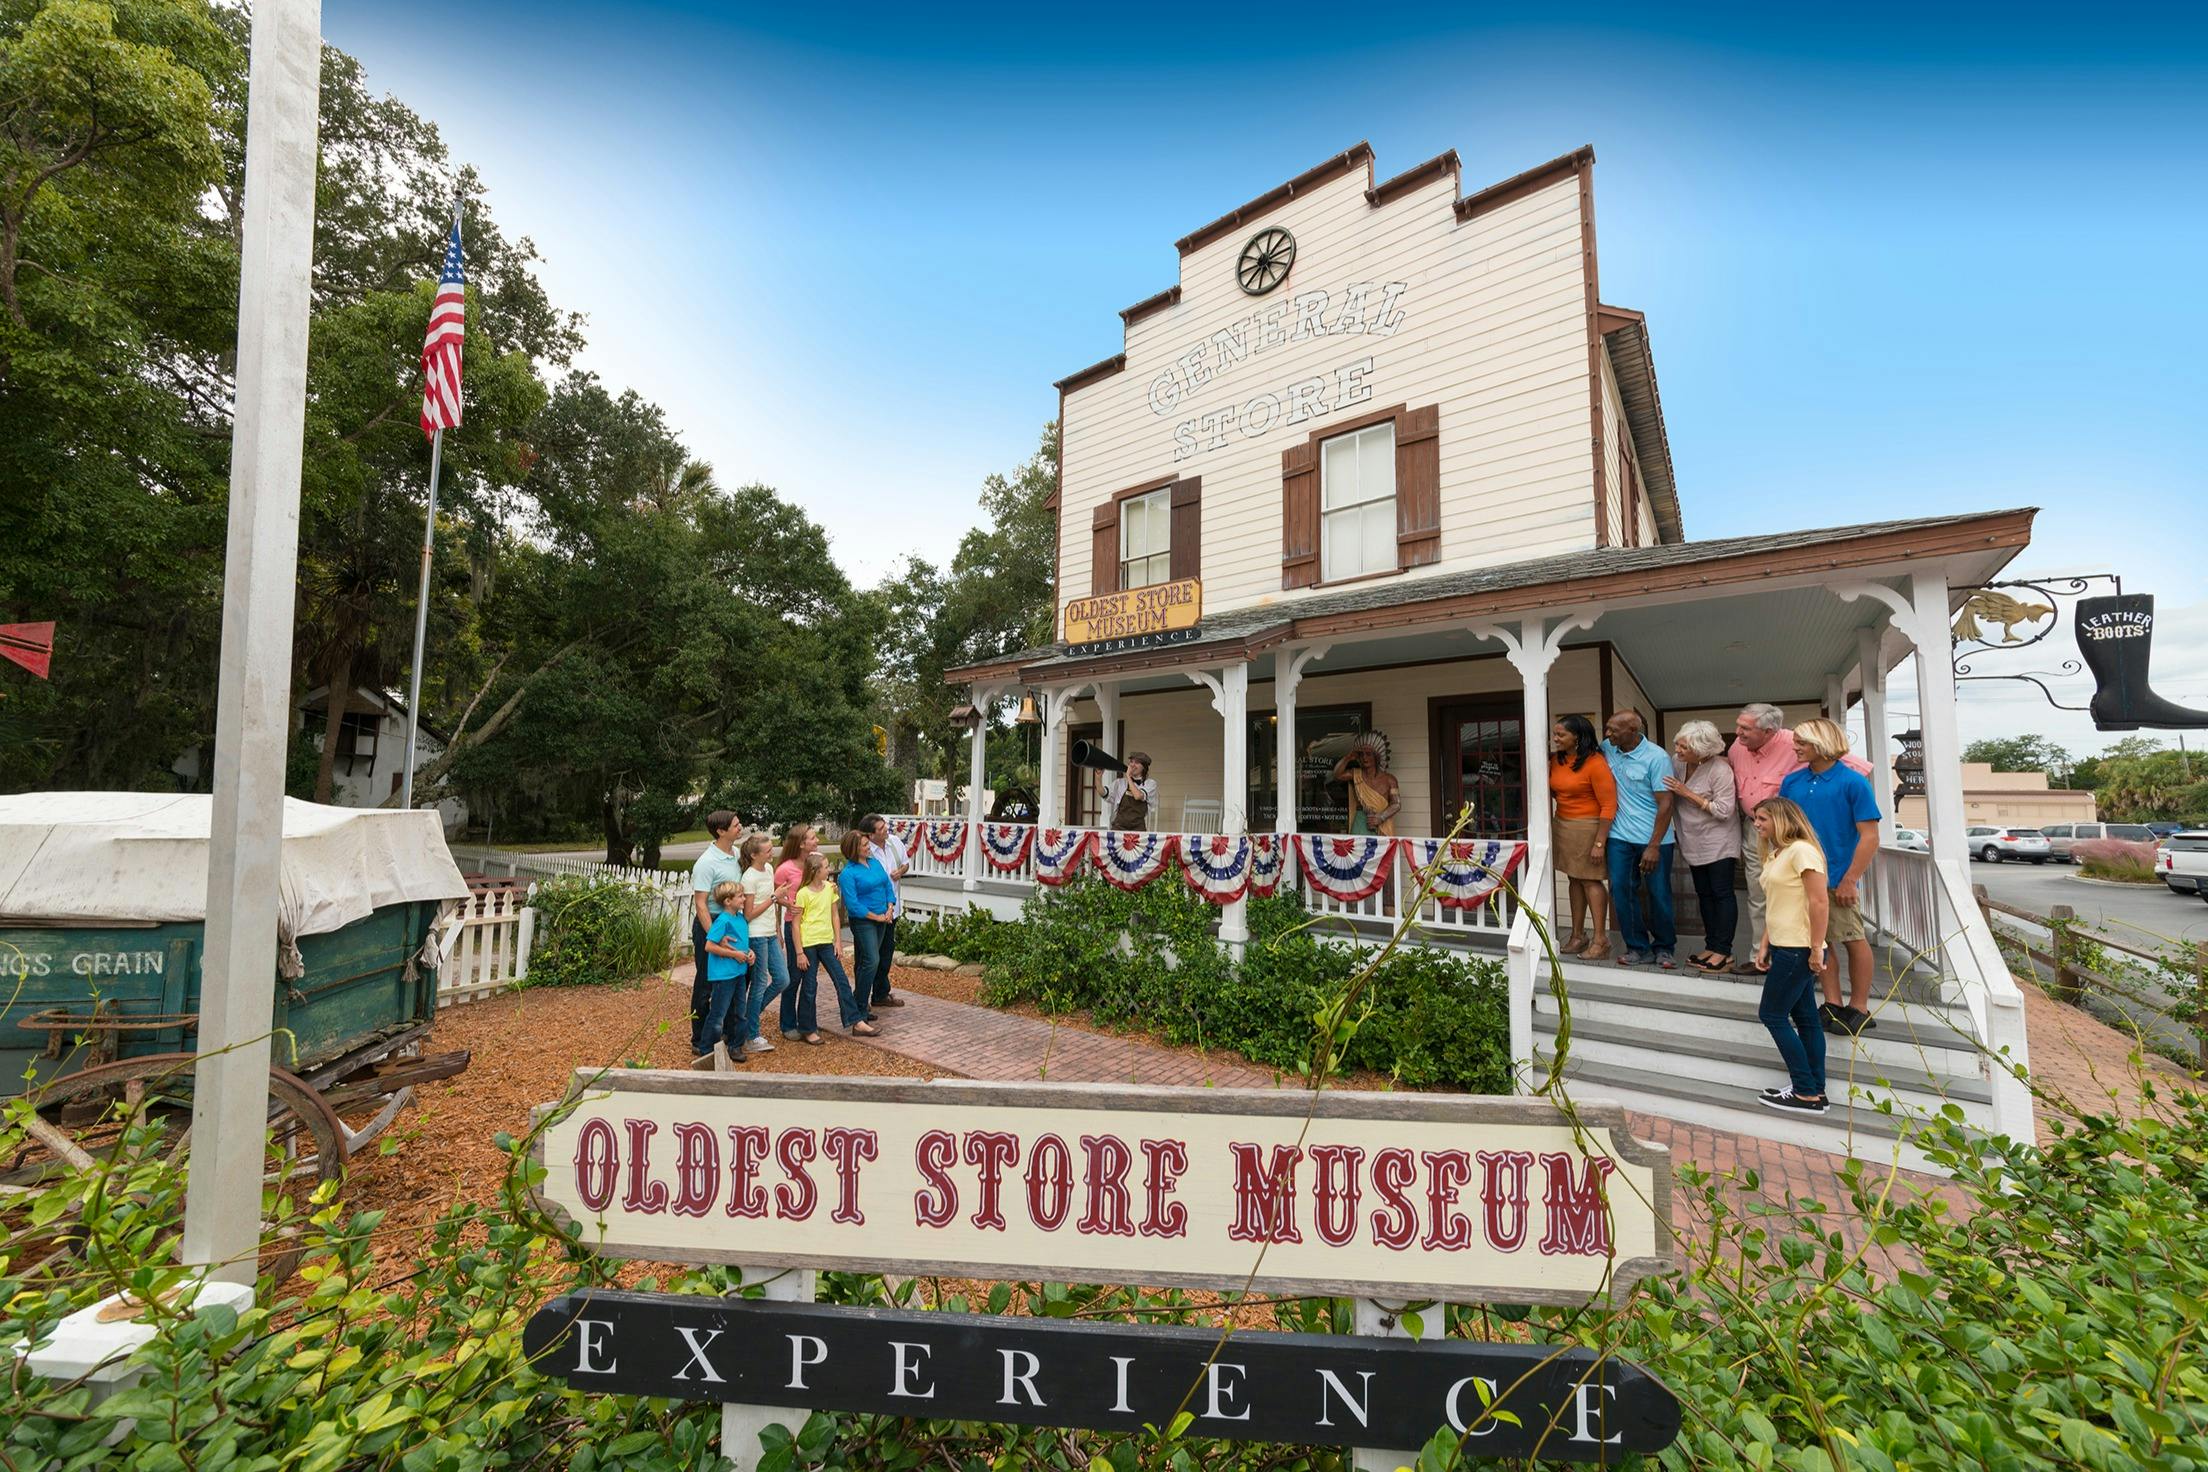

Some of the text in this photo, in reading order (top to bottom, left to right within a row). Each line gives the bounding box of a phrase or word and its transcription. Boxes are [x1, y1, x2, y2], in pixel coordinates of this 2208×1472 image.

[1147, 281, 1408, 416] GENERAL
[1174, 356, 1374, 463] STORE
[1069, 583, 1194, 622] OLDEST STORE
[1086, 607, 1168, 640] MUSEUM
[2081, 611, 2152, 631] LEATHER
[2093, 625, 2144, 640] BOOTS
[1069, 630, 1194, 655] EXPERIENCE
[1902, 750, 1923, 760] STOV
[1903, 741, 1922, 749] WOO
[1906, 775, 1925, 784] HER
[71, 951, 163, 976] GRAIN
[573, 1117, 1617, 1258] OLDEST STORE MUSEUM
[572, 1319, 1623, 1444] EXPERIENCE
